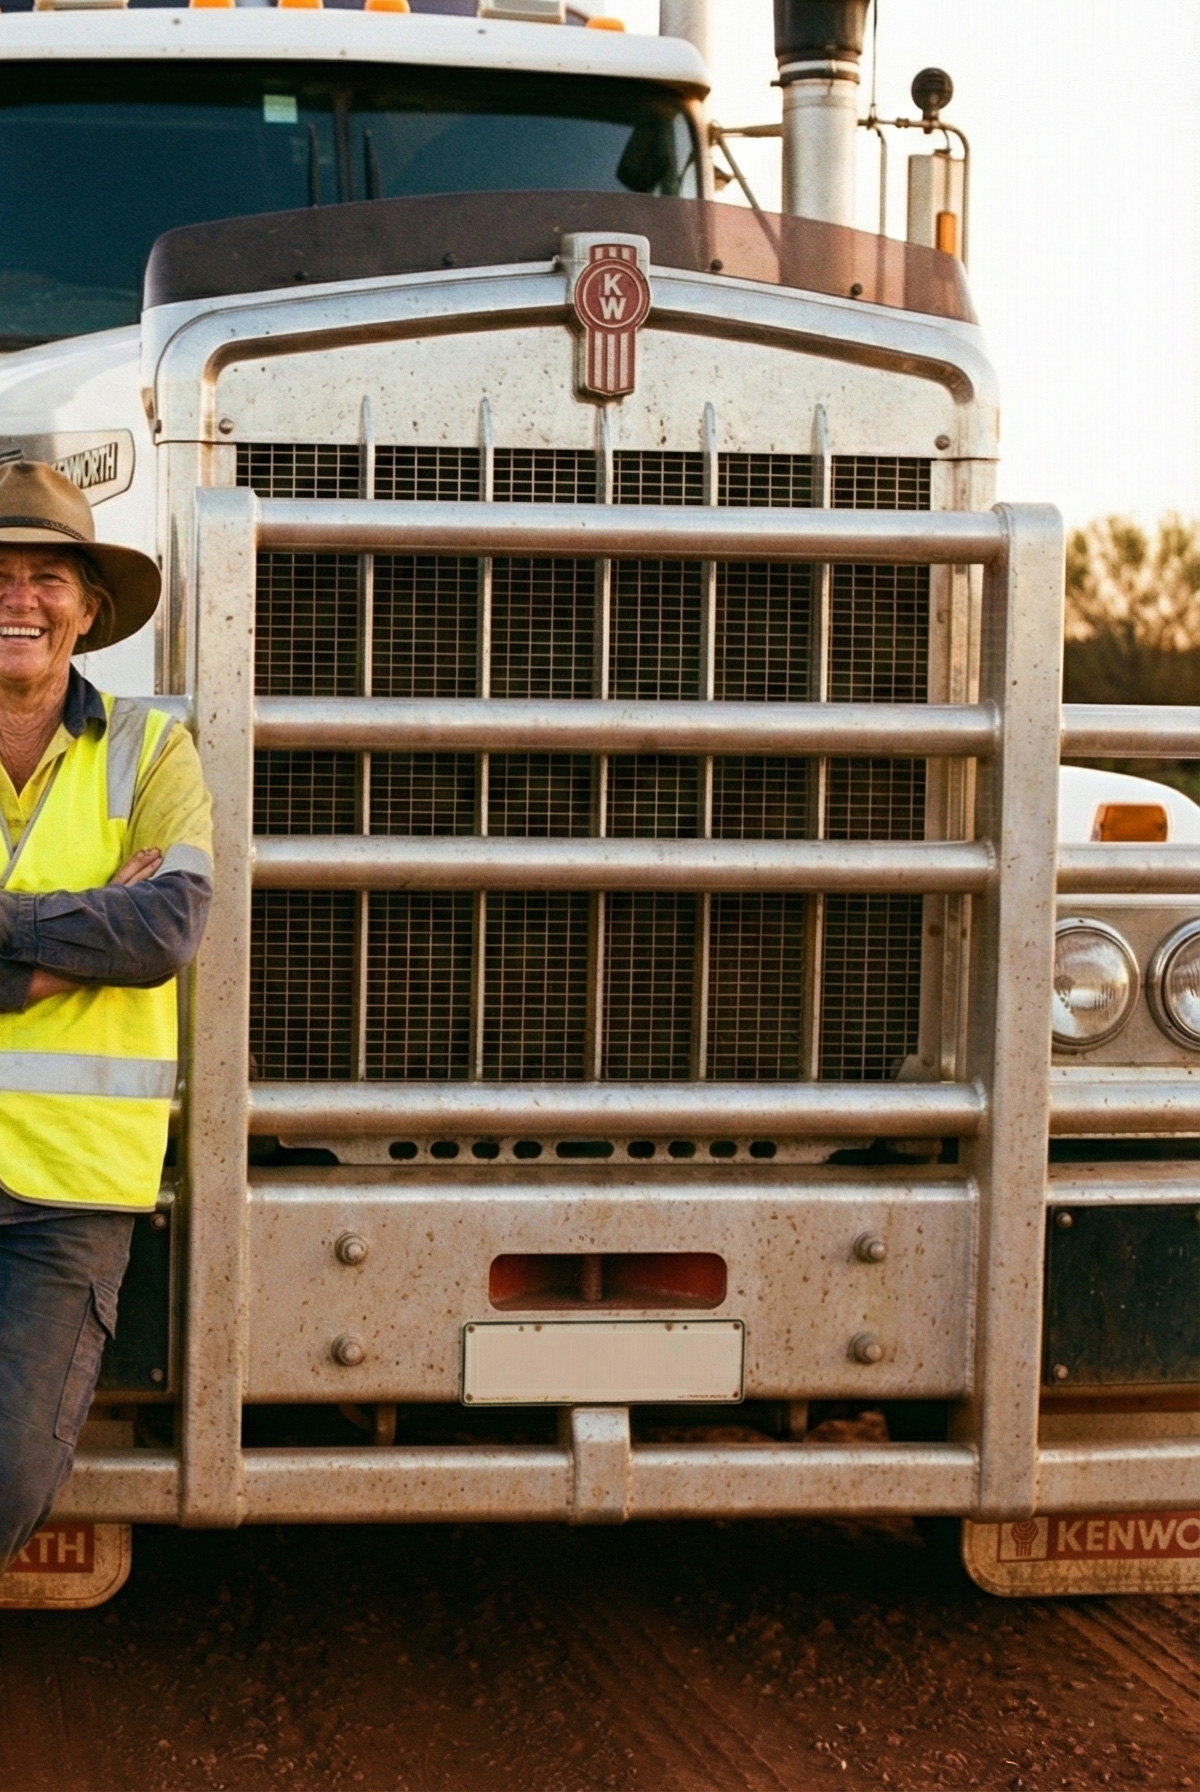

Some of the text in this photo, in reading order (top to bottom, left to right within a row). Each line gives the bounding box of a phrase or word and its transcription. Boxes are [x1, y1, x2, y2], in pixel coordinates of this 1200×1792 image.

[603, 273, 623, 296] K
[599, 297, 627, 320] W
[52, 442, 118, 489] WORTH
[1057, 1517, 1200, 1552] KENWO
